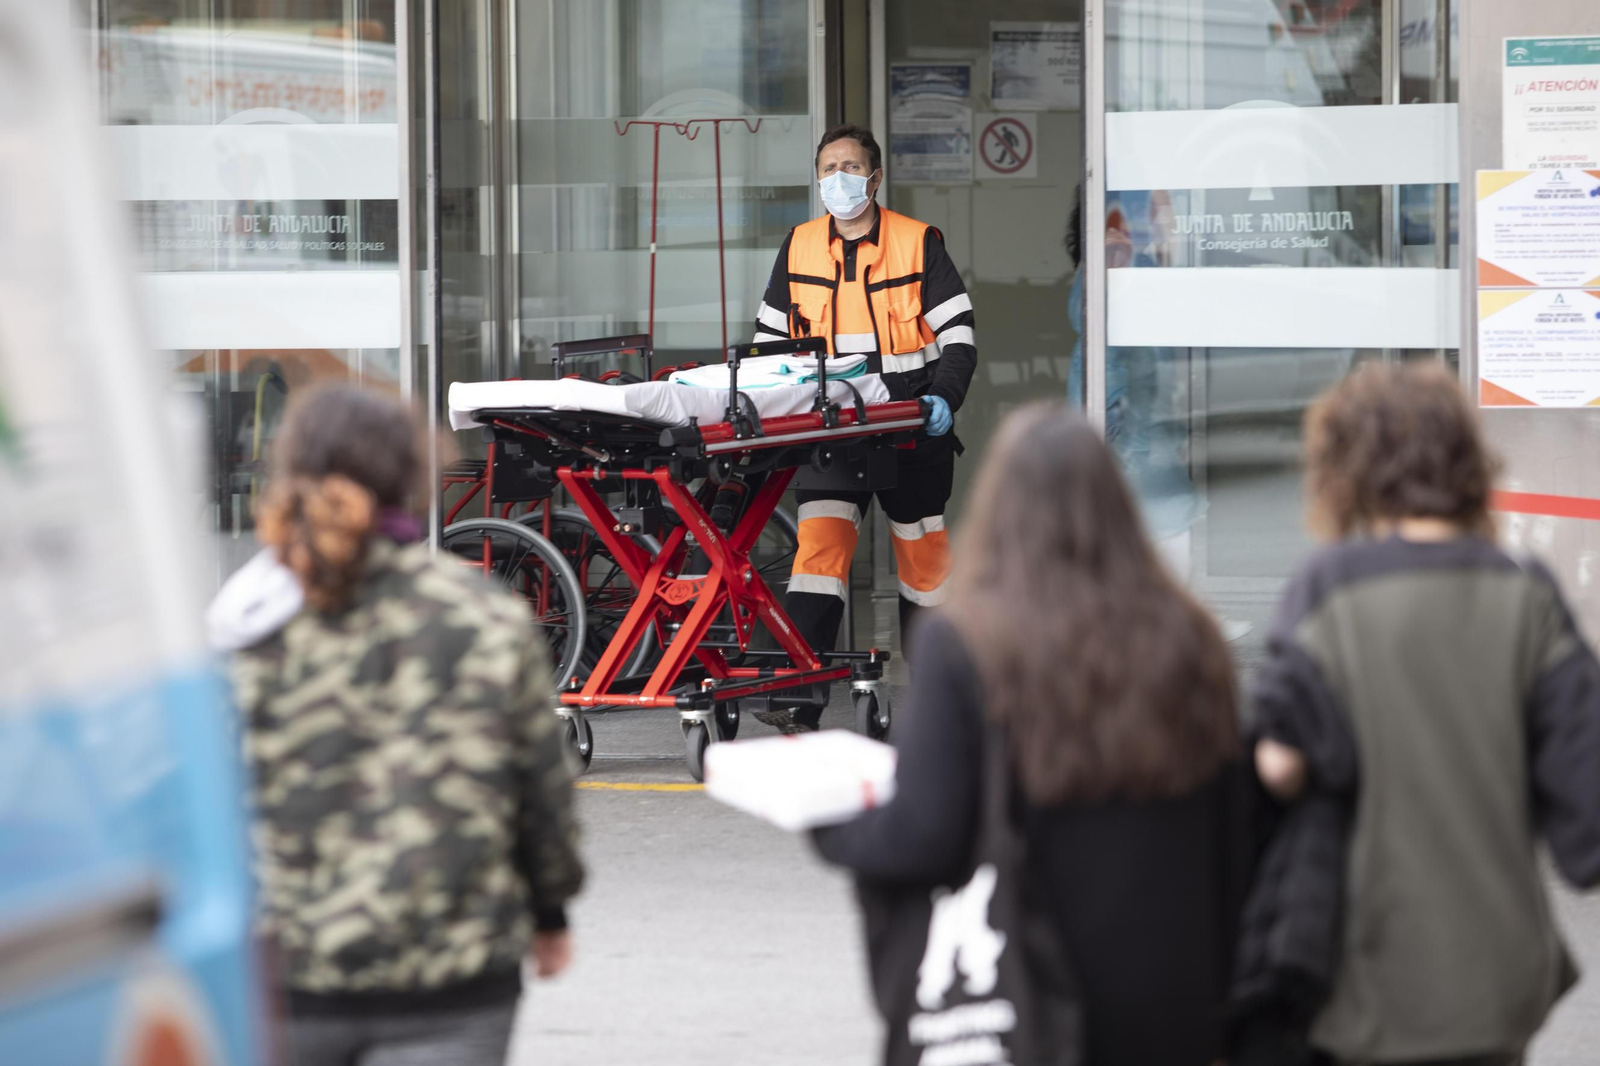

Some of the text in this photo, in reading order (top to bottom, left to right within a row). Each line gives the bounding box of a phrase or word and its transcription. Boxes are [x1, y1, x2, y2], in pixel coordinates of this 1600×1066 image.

[1527, 78, 1599, 91] ATENCIÓN
[187, 214, 352, 234] JUNTA DE ANDALUCIA
[1171, 211, 1355, 235] JUNTA DE ANDALUCIA
[269, 241, 298, 250] SALUD
[346, 241, 386, 251] SOCIALES
[1198, 236, 1330, 254] Consejería de Salud
